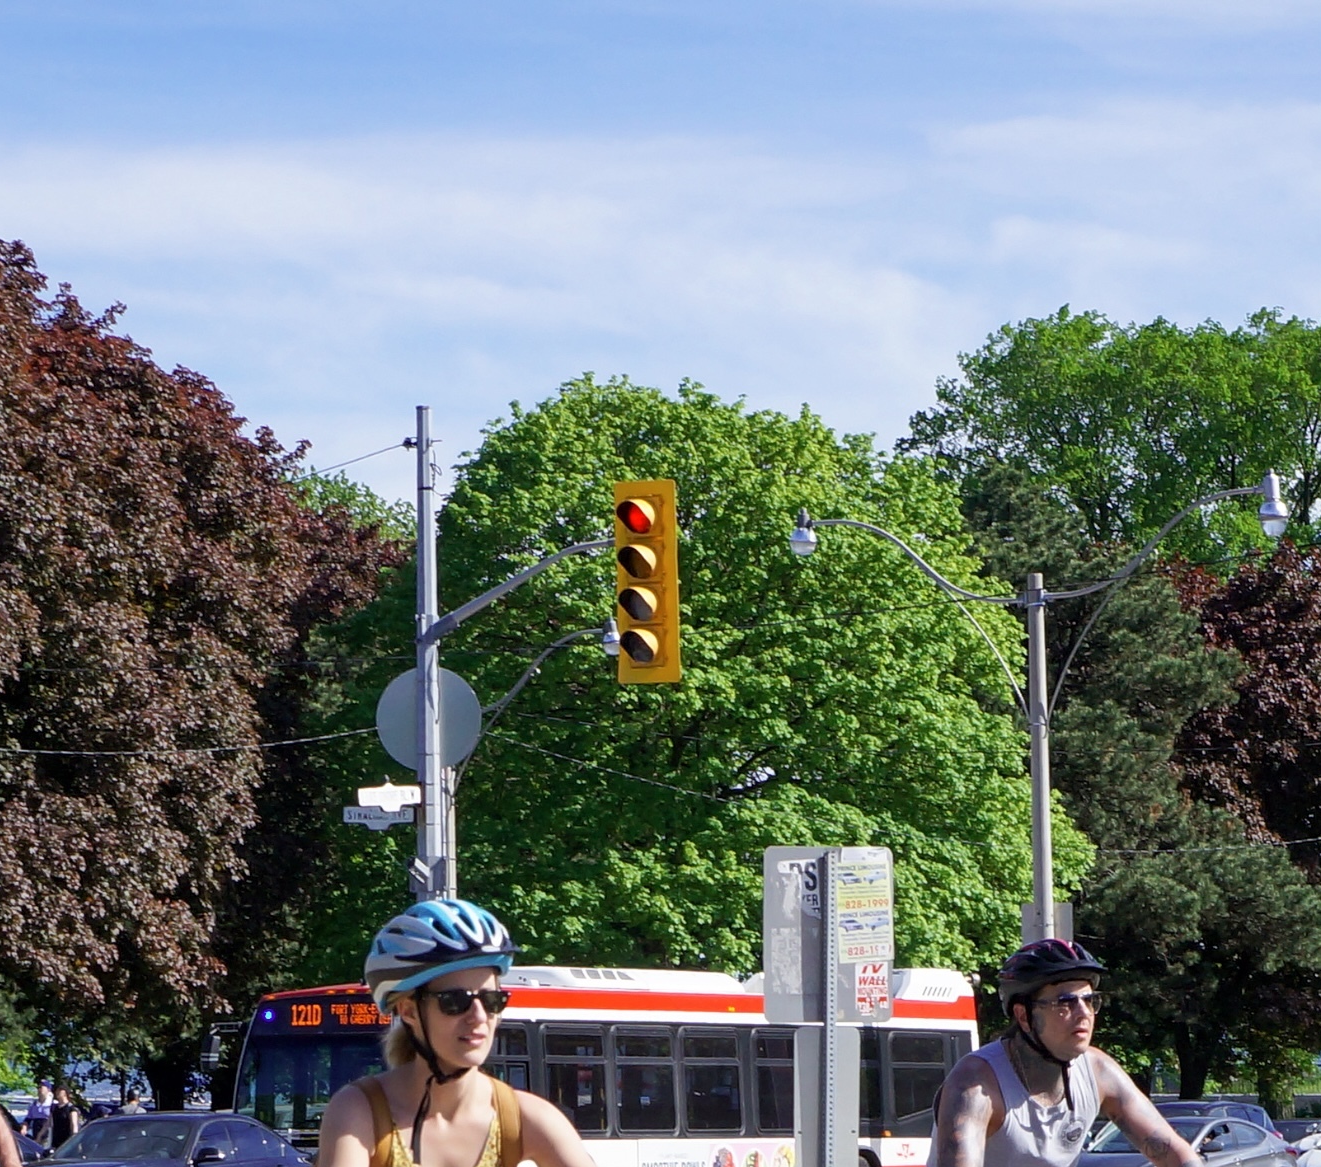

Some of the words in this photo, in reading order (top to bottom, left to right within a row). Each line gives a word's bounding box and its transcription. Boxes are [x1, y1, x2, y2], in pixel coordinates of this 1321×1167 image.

[845, 898, 889, 909] 828-1999
[858, 976, 886, 986] WALL
[291, 1004, 322, 1026] 121D
